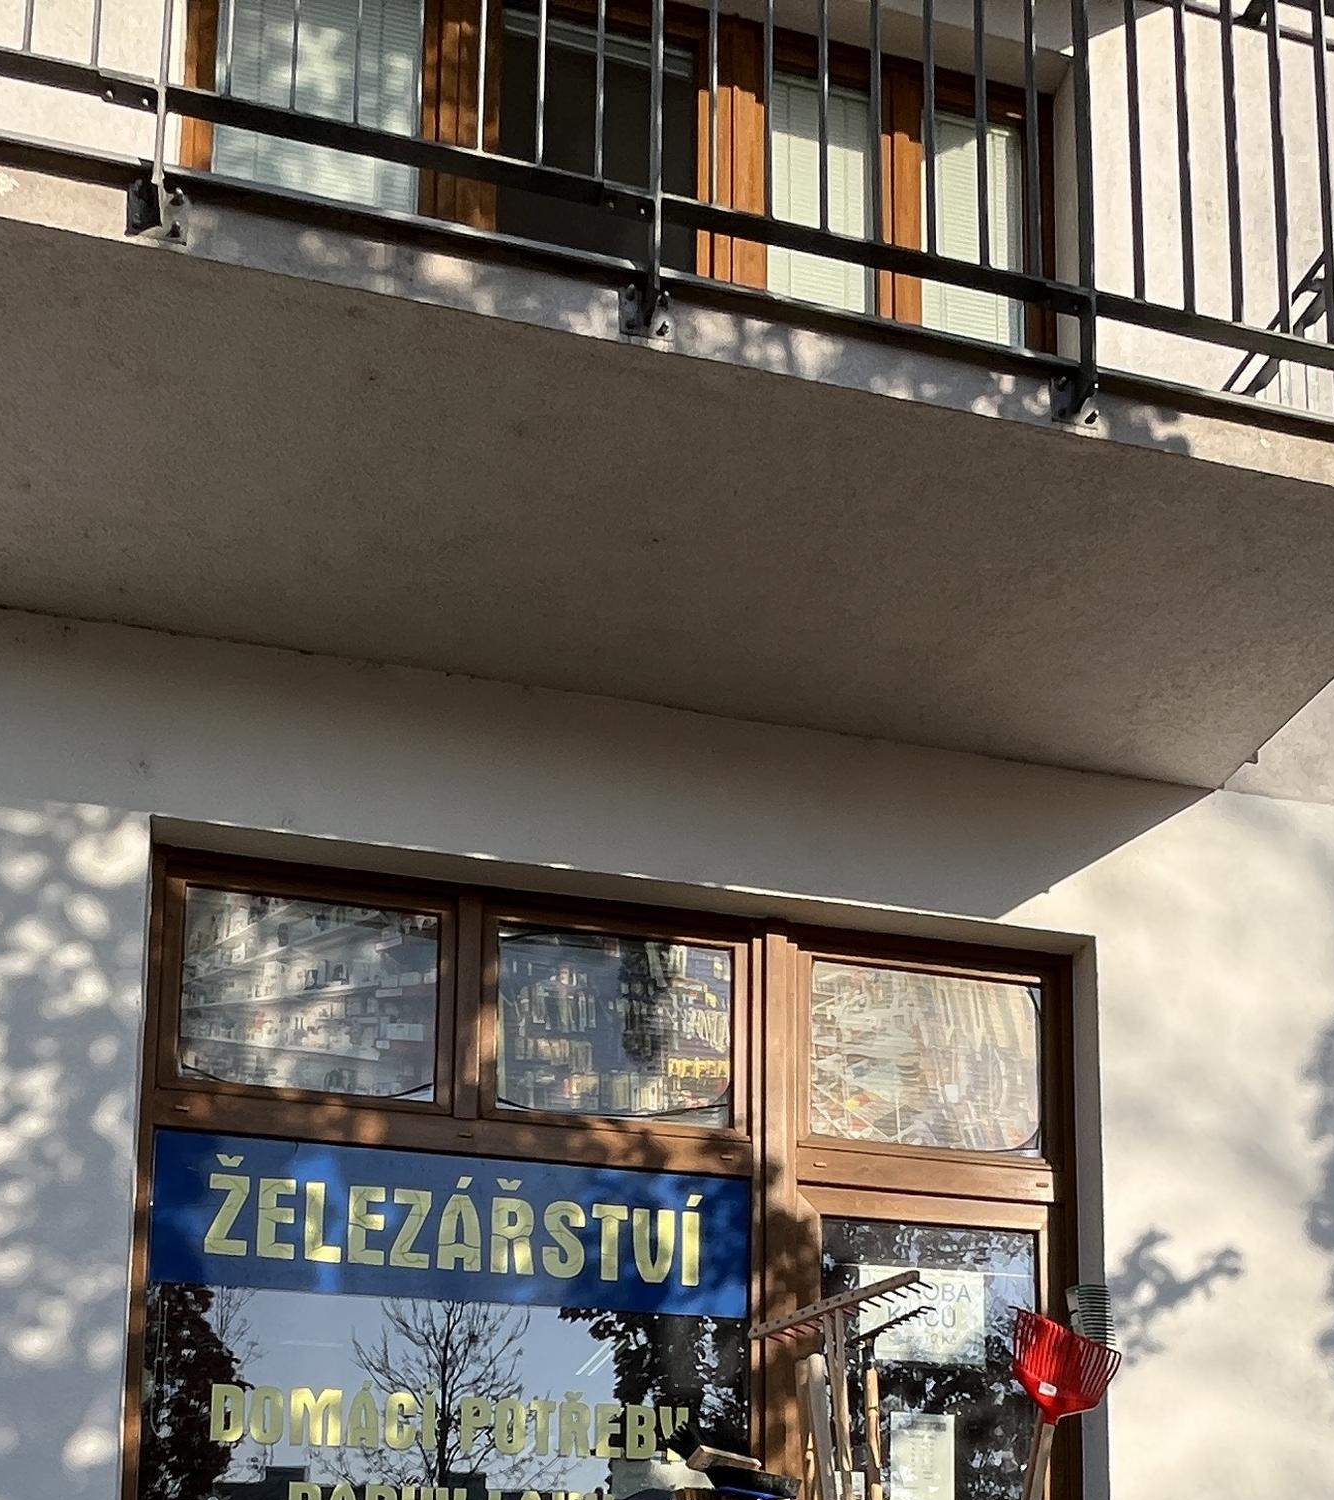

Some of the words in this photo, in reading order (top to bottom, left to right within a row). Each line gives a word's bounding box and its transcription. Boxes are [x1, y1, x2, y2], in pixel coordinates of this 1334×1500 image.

[203, 1153, 704, 1287] ŽELEZÁŘSTVÍ
[209, 1380, 438, 1450] DOMÁCÍ
[459, 1391, 690, 1463] POTŘEBY
